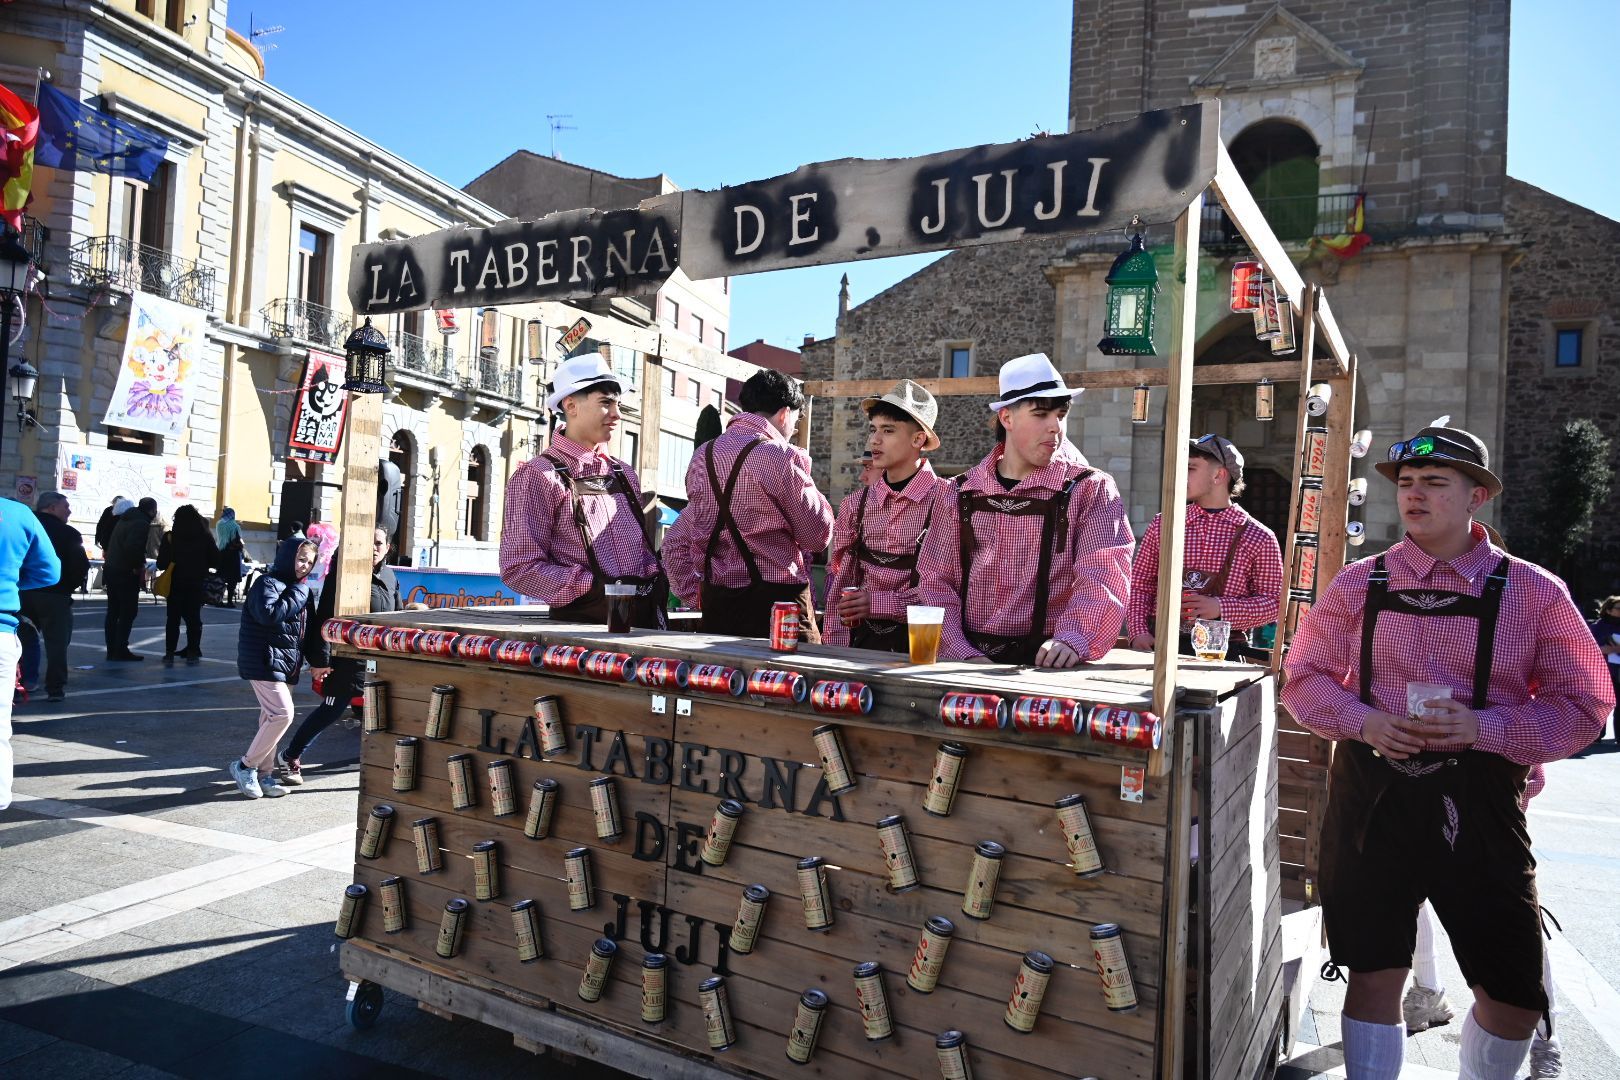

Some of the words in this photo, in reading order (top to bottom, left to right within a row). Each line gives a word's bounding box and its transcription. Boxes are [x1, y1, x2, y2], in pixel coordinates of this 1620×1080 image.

[367, 260, 418, 307] LA
[450, 226, 673, 293] TABERNA
[732, 192, 820, 256] DE
[919, 157, 1112, 235] JUJI
[564, 322, 584, 346] 1906
[1311, 438, 1324, 471] 1906
[1302, 494, 1316, 527] 1906
[1300, 551, 1314, 584] 1906
[476, 708, 543, 762] LA
[575, 723, 845, 823] TABERNA
[631, 810, 706, 875] DE
[603, 894, 734, 978] JUJI
